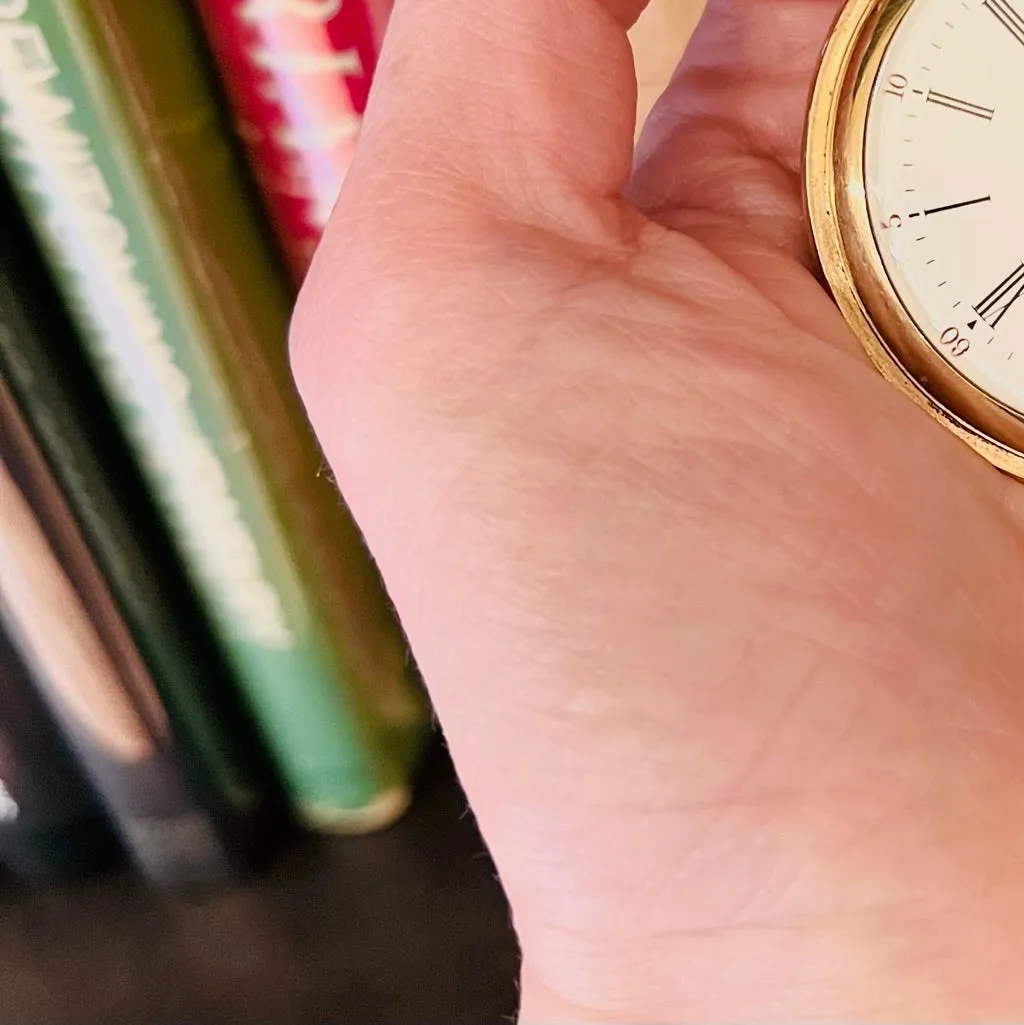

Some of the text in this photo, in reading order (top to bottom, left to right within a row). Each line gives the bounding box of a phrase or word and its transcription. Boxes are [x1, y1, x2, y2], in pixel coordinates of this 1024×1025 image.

[883, 72, 909, 102] 10
[925, 87, 996, 121] II
[879, 213, 902, 230] 5
[939, 326, 971, 357] 60
